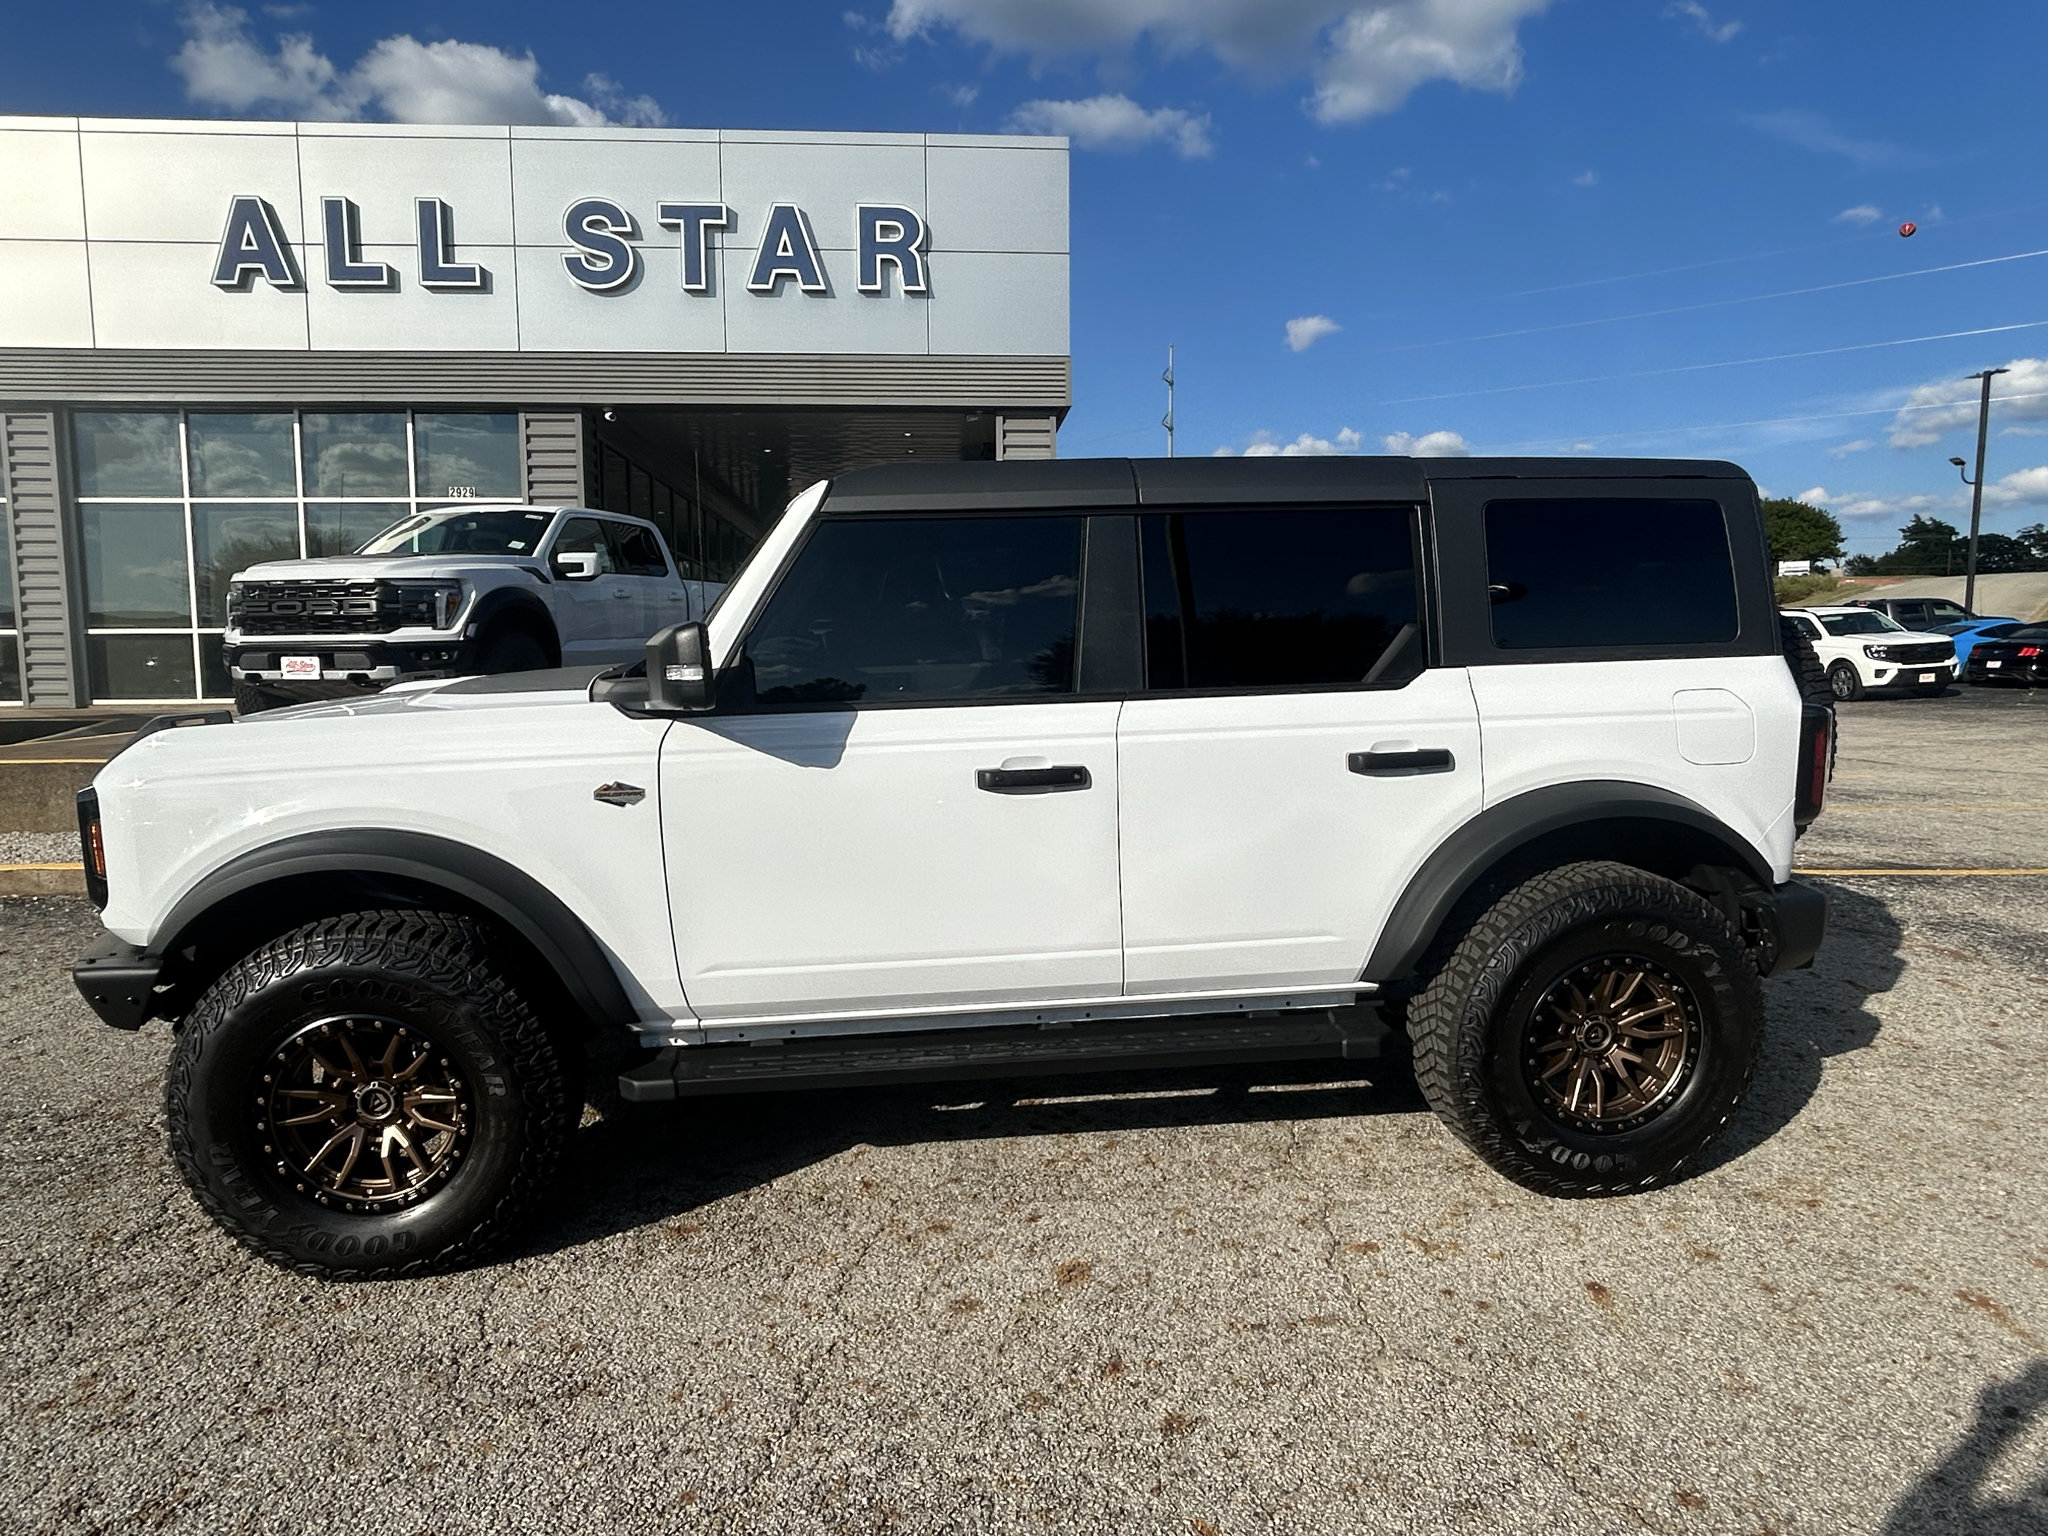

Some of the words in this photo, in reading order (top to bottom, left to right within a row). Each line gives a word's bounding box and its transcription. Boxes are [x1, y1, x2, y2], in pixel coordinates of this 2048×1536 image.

[212, 195, 492, 293] ALL
[560, 197, 929, 294] STAR
[449, 487, 475, 498] 2929
[241, 599, 378, 615] FORD
